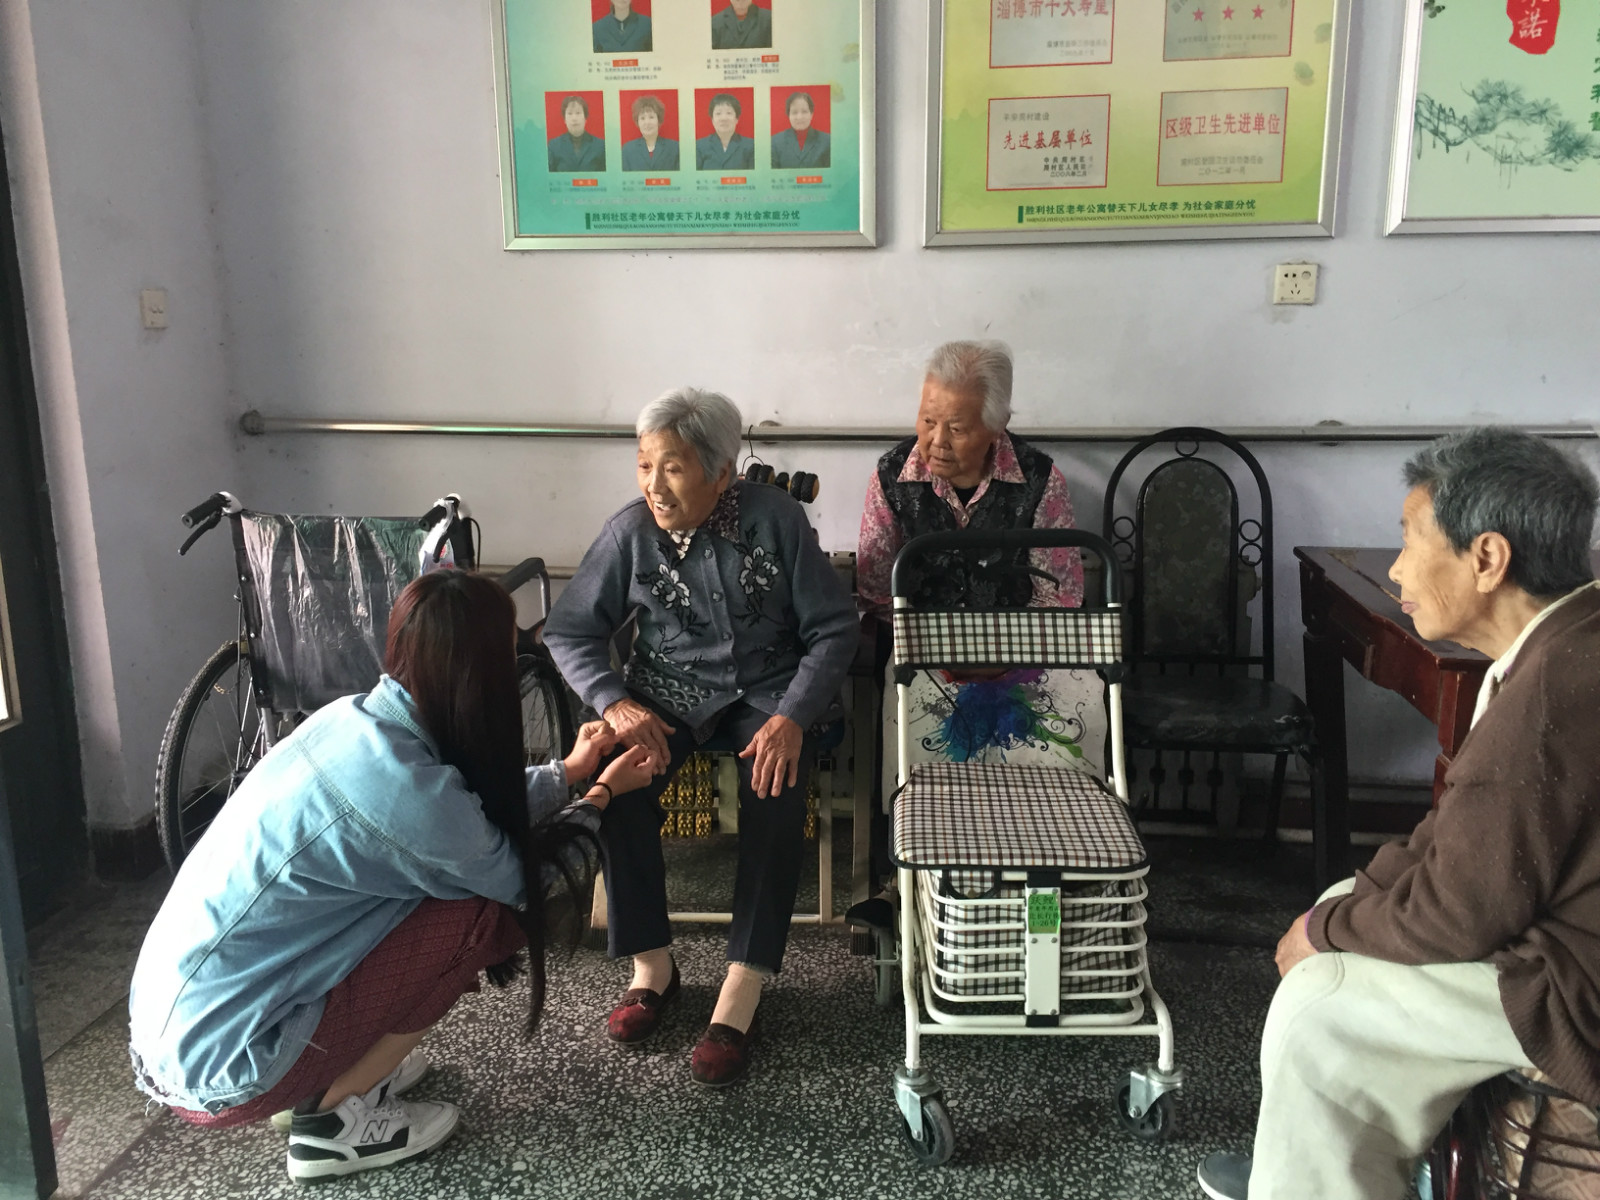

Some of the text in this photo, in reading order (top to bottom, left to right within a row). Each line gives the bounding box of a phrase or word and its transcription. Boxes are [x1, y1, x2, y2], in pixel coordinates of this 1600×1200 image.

[1165, 112, 1281, 138] 区级卫生先进单位
[1003, 128, 1093, 150] 先进基层单位
[592, 210, 800, 222] 胜利社区老年公寓替天下儿女尽孝 为社会家庭分忧
[1025, 199, 1256, 215] 胜利社区老年公寓替天下儿女尽孝 为社会家庭分忧
[360, 1119, 389, 1143] N
